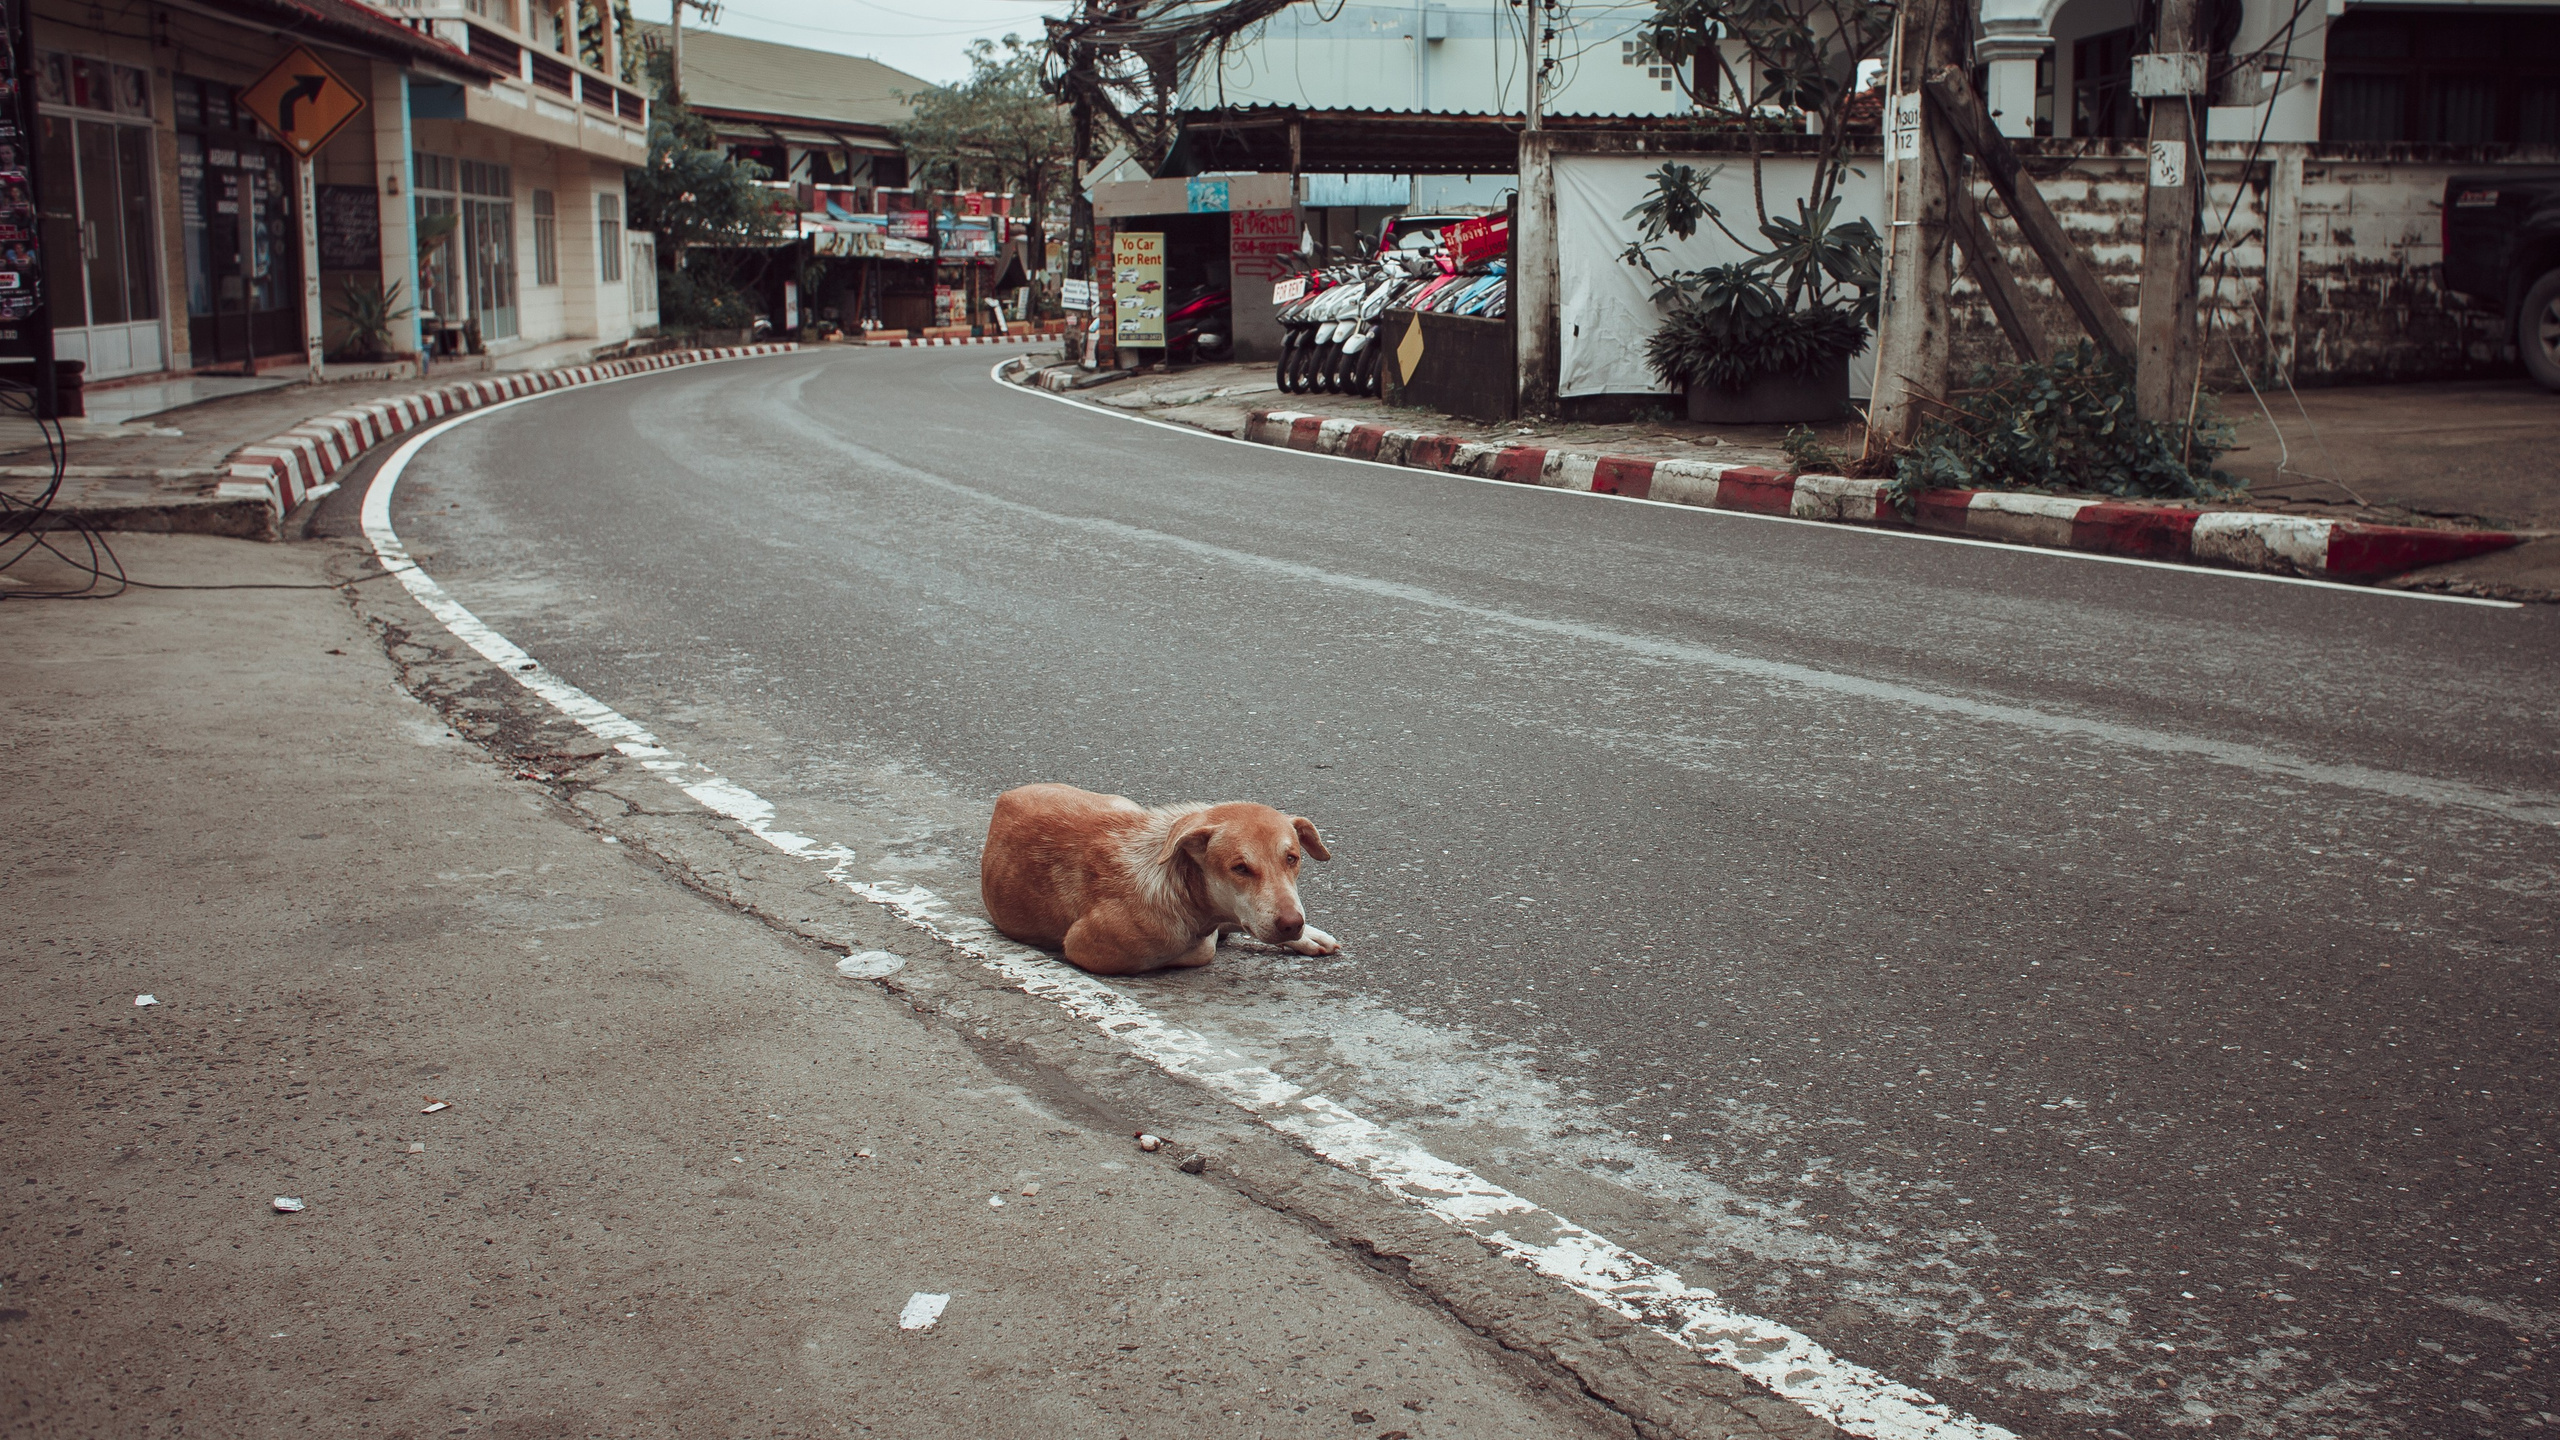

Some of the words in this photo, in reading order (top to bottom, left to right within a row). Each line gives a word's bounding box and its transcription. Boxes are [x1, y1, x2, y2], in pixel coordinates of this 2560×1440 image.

[1121, 238, 1134, 250] Yo
[1136, 238, 1154, 250] Car
[1117, 254, 1134, 265] For
[1137, 254, 1162, 265] Rent
[1276, 283, 1287, 300] FOR
[1288, 279, 1304, 297] RENT
